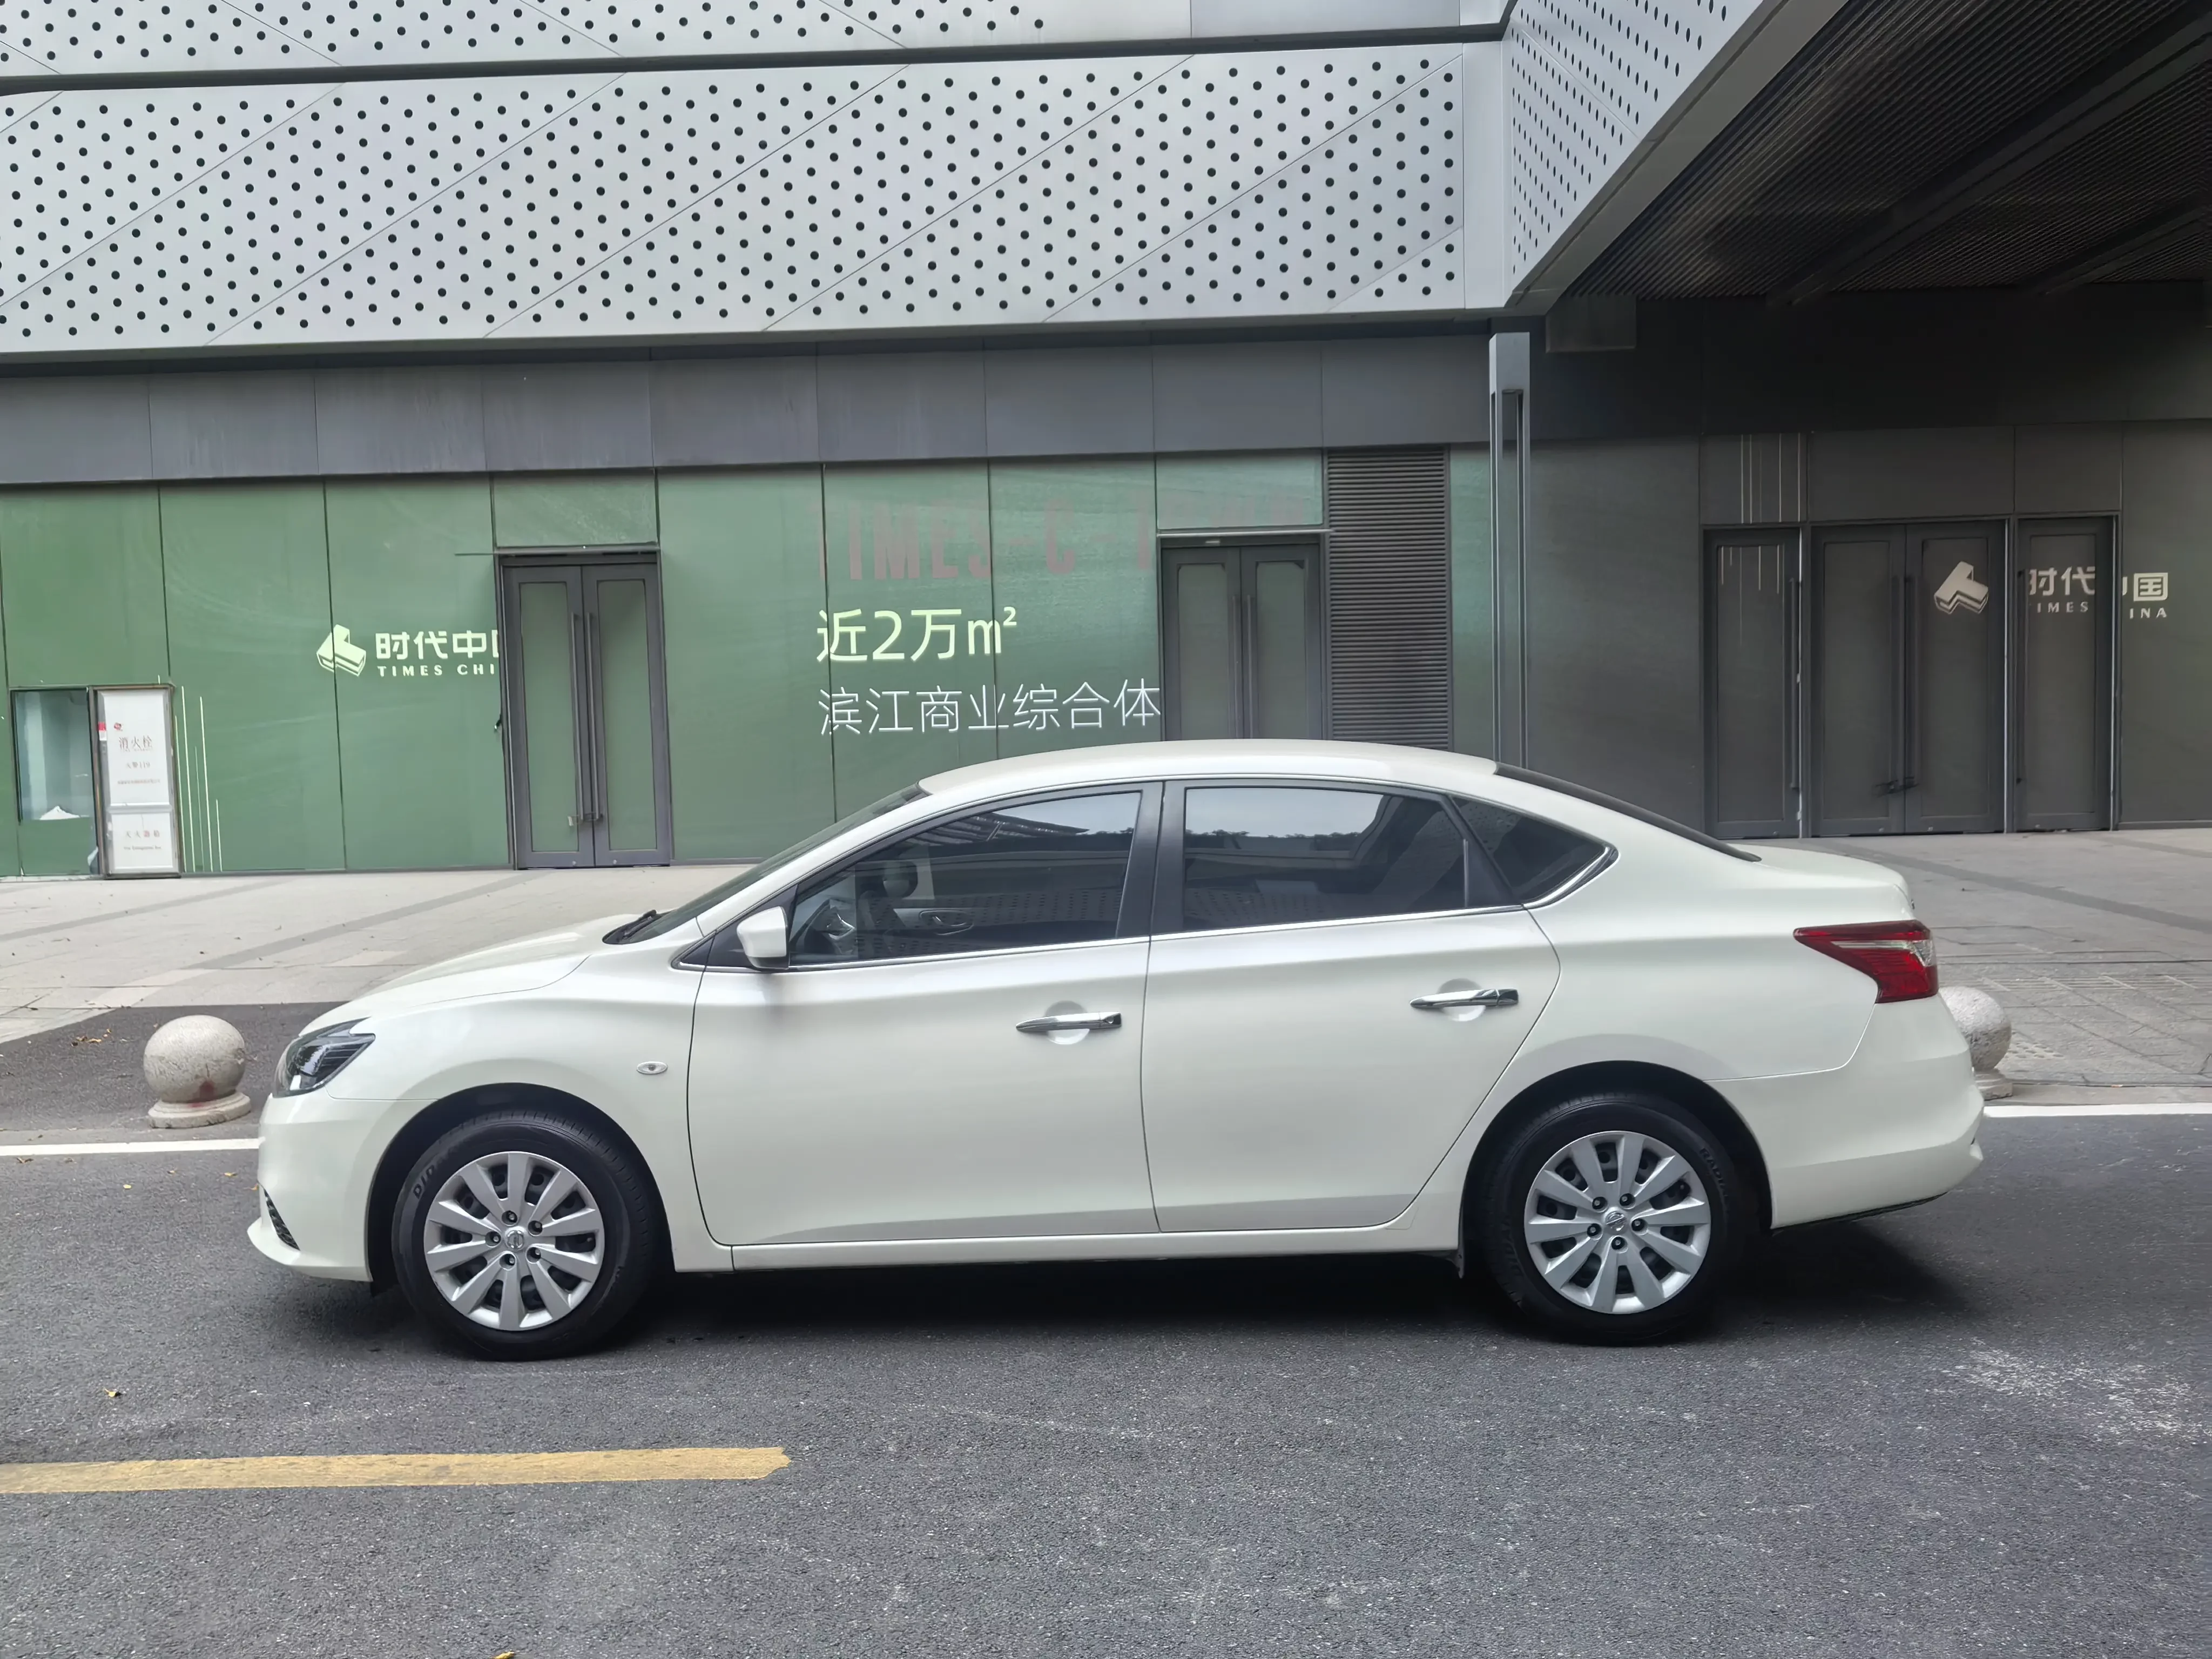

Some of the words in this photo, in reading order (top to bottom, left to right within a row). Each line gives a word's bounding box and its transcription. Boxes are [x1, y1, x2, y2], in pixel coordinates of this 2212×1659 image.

[375, 630, 499, 660] 时代中
[377, 665, 443, 677] TIMES
[818, 678, 1161, 735] 滨江商业综合体
